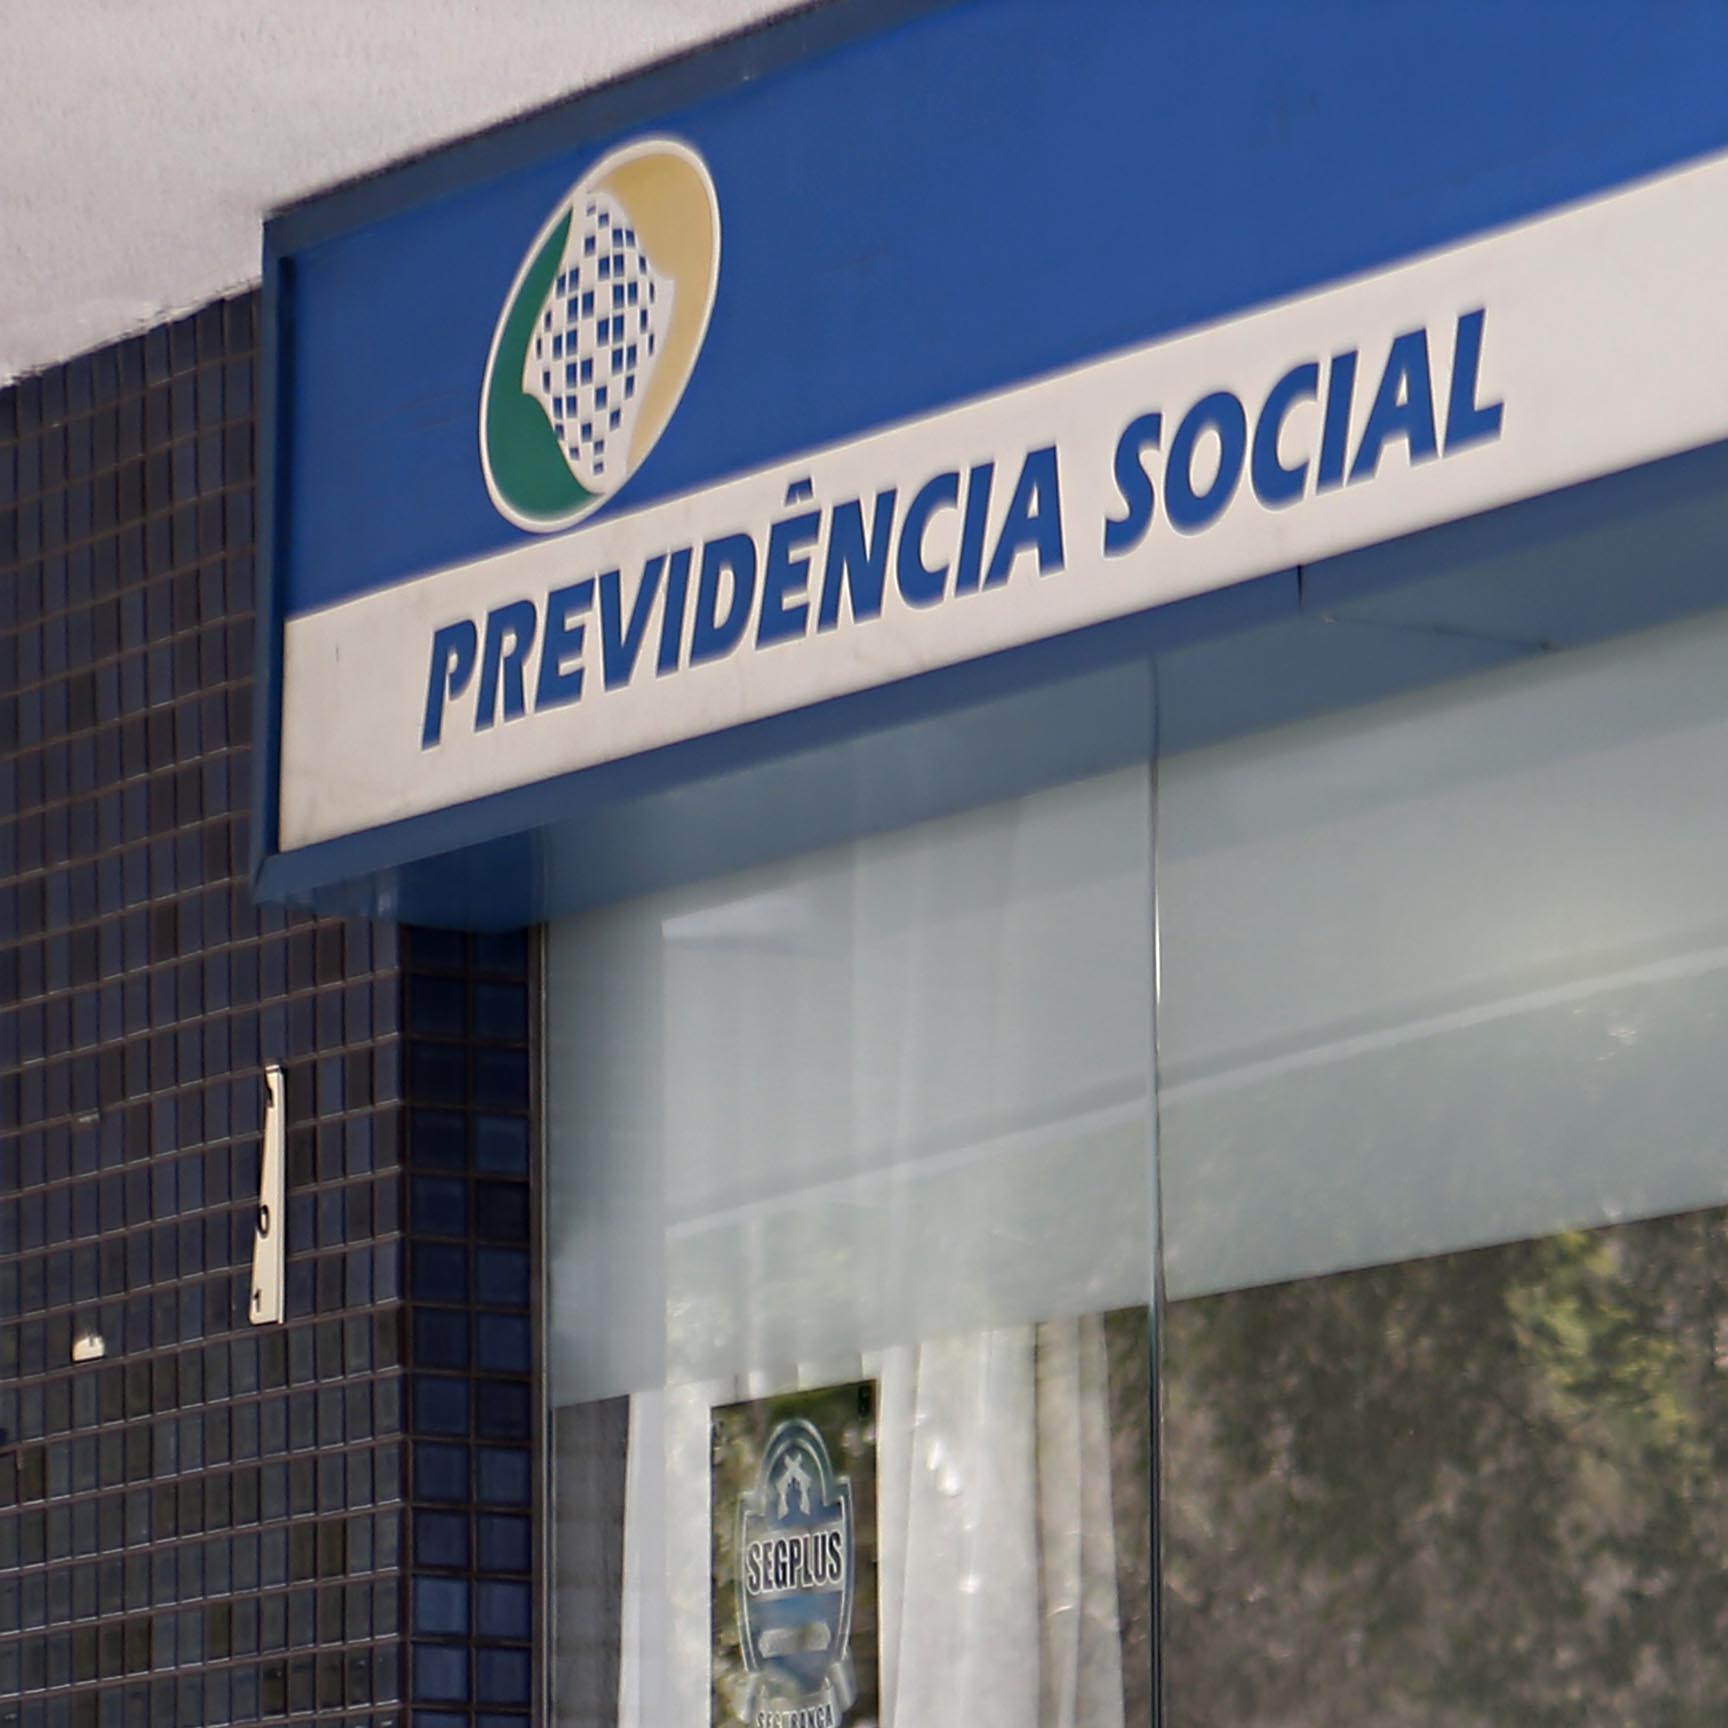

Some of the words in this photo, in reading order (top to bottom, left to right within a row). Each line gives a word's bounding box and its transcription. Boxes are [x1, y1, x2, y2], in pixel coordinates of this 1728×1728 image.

[420, 443, 1067, 751] PREVIDÊNCIA
[1103, 307, 1504, 559] SOCIAL
[746, 1529, 843, 1597] SEGPLUS
